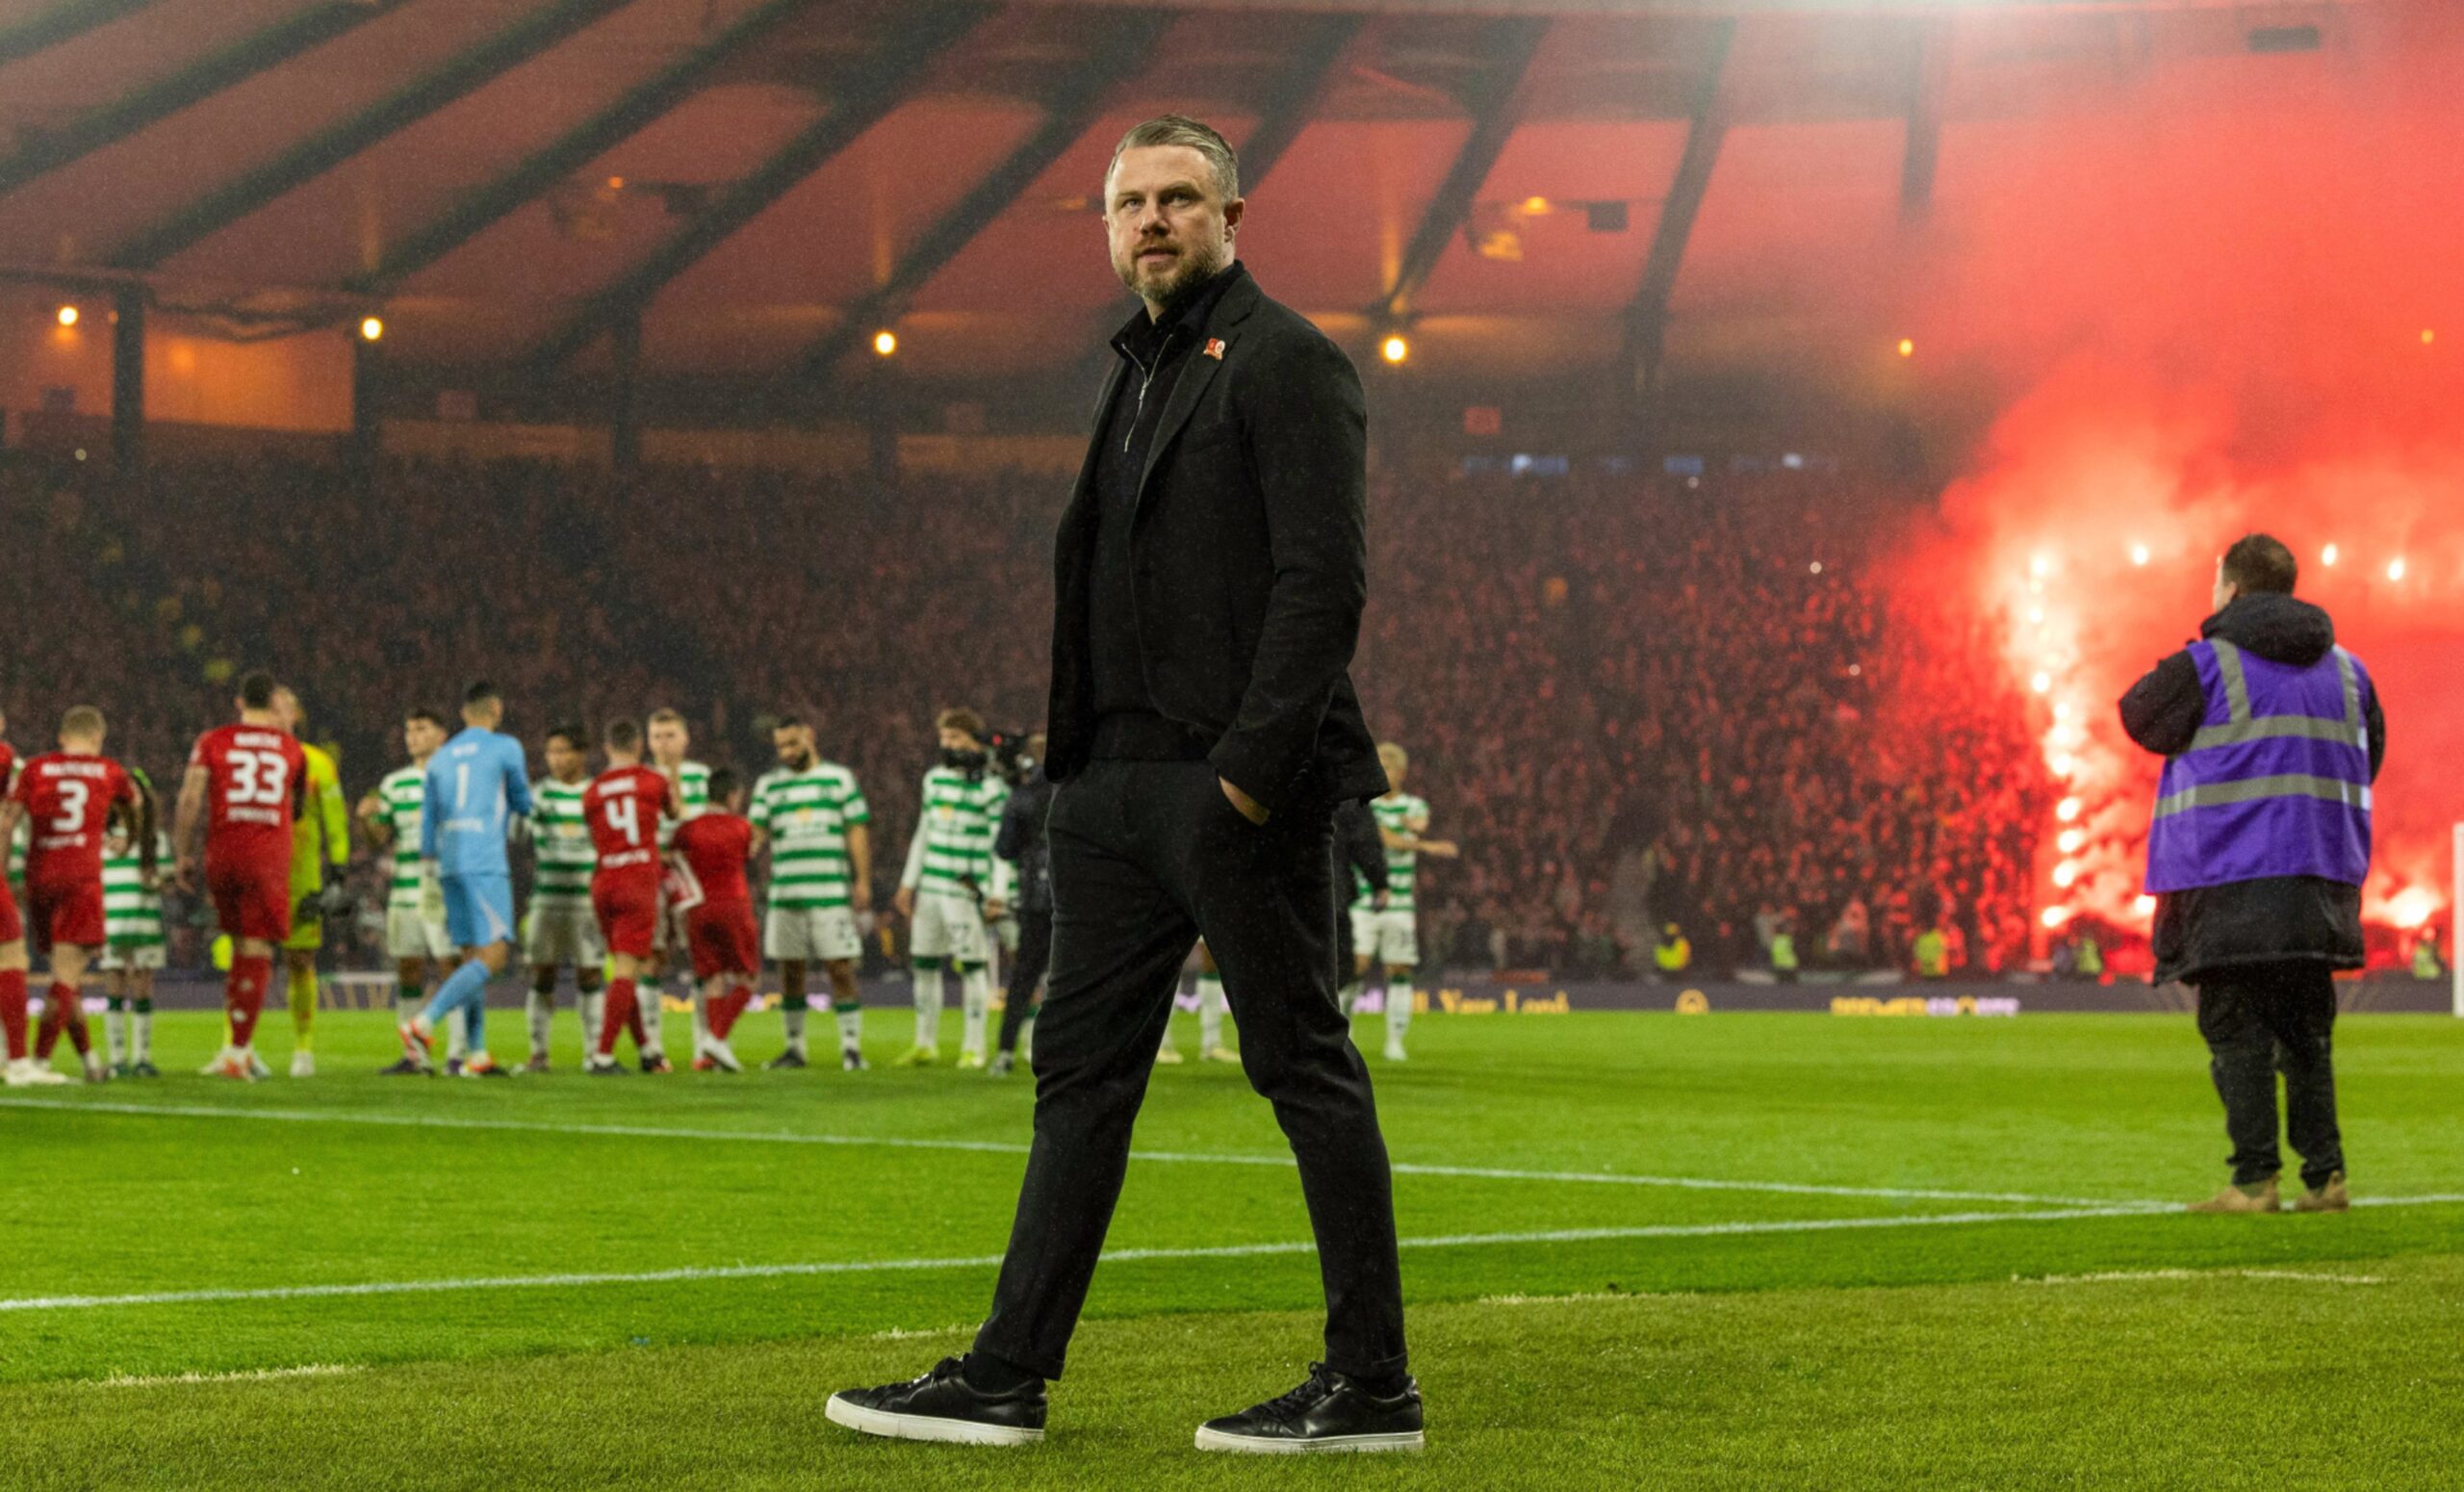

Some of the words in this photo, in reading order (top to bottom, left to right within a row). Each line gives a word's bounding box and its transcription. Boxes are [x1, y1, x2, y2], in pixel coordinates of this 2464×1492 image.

[225, 749, 289, 805] 33
[456, 762, 470, 810] 1
[52, 779, 89, 832] 3
[605, 794, 640, 846] 4
